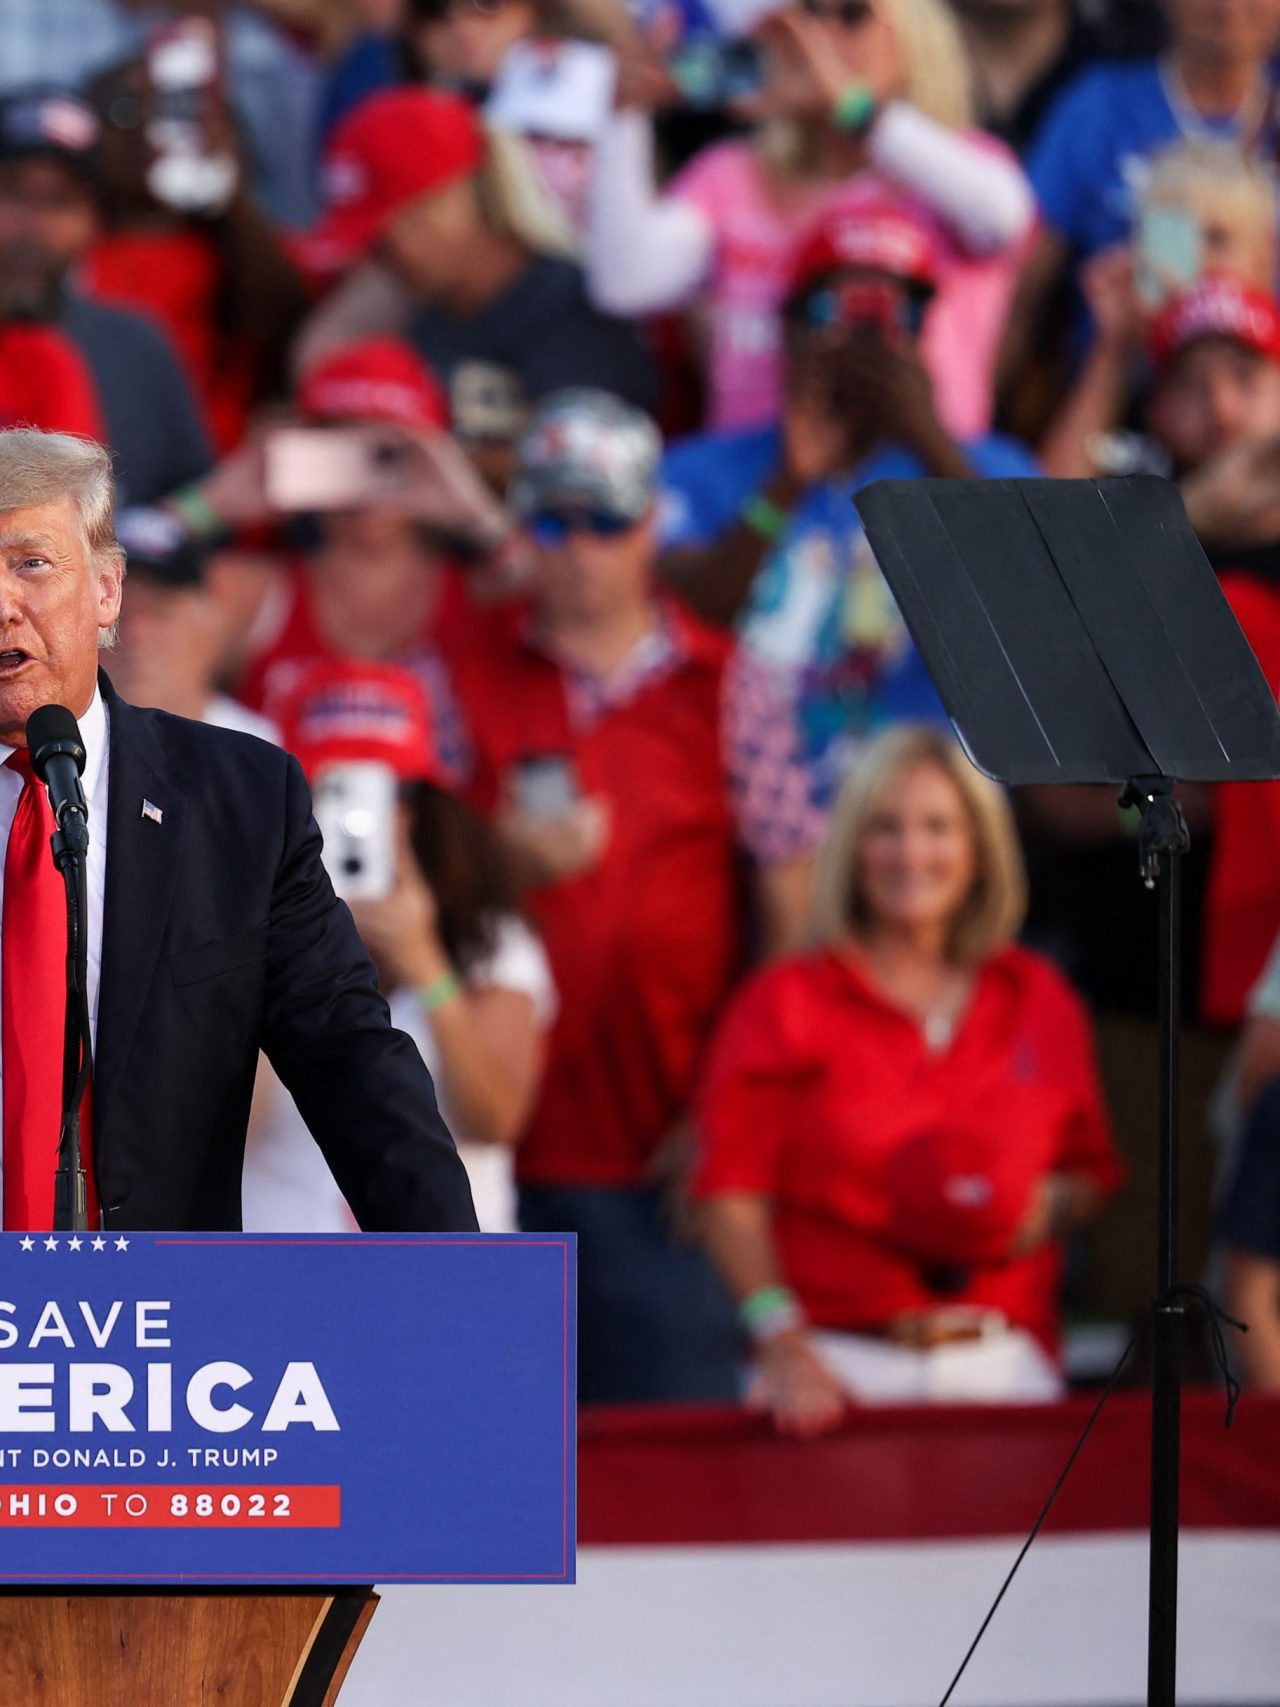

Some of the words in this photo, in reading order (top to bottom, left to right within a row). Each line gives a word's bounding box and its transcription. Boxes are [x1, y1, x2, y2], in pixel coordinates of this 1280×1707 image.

[33, 1448, 146, 1468] DONALD
[156, 1448, 177, 1467] J.
[187, 1448, 278, 1467] TRUMP
[100, 1493, 148, 1517] TO
[170, 1493, 291, 1517] 88022
